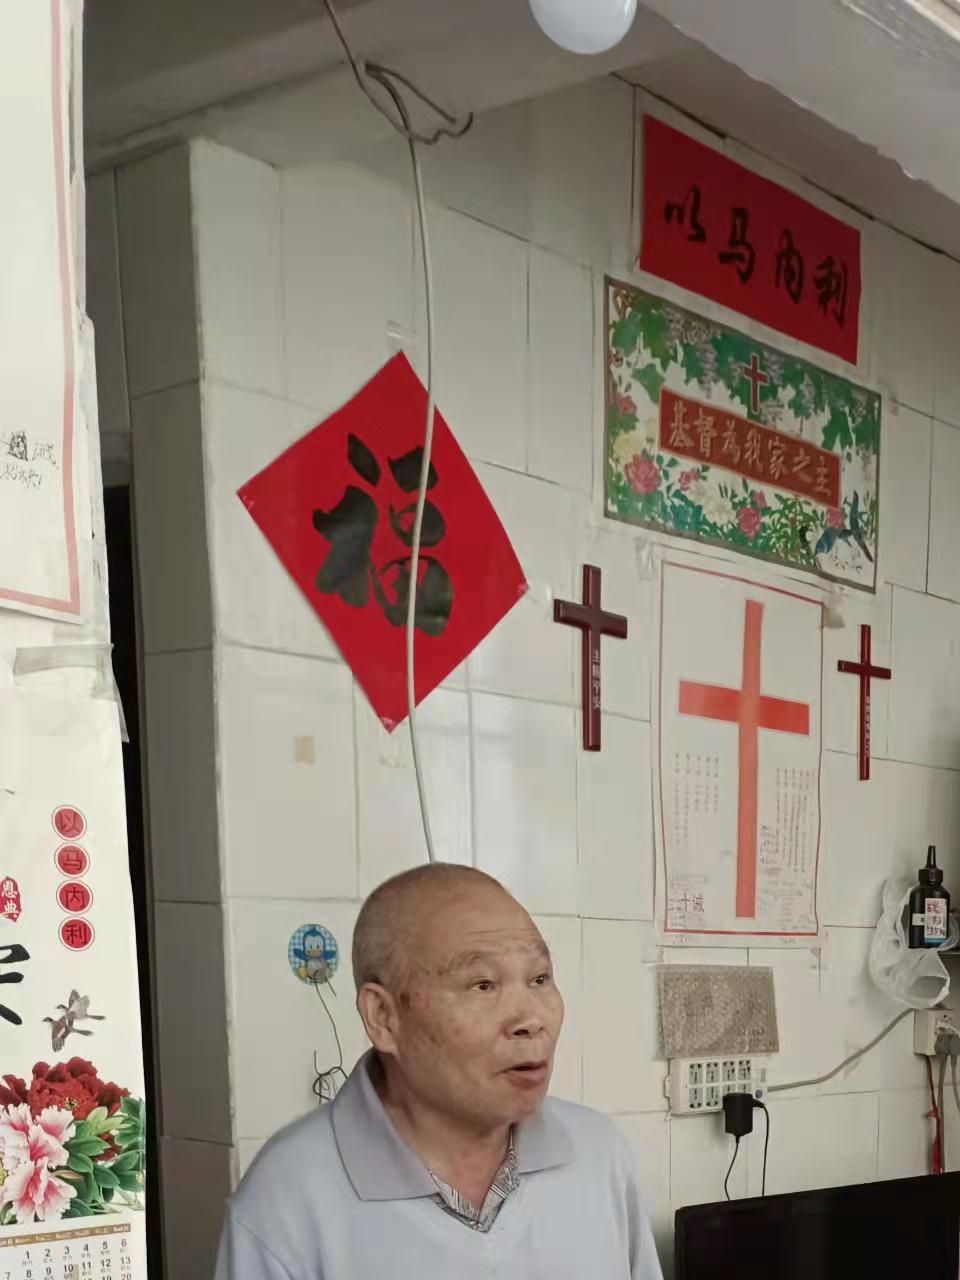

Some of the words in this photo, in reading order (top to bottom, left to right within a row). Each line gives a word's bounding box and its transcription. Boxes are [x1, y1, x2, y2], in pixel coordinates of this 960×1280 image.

[664, 186, 848, 327] 以马内利
[669, 400, 833, 499] 基督為我家之主
[313, 433, 453, 638] 福
[58, 811, 90, 947] 以马内利
